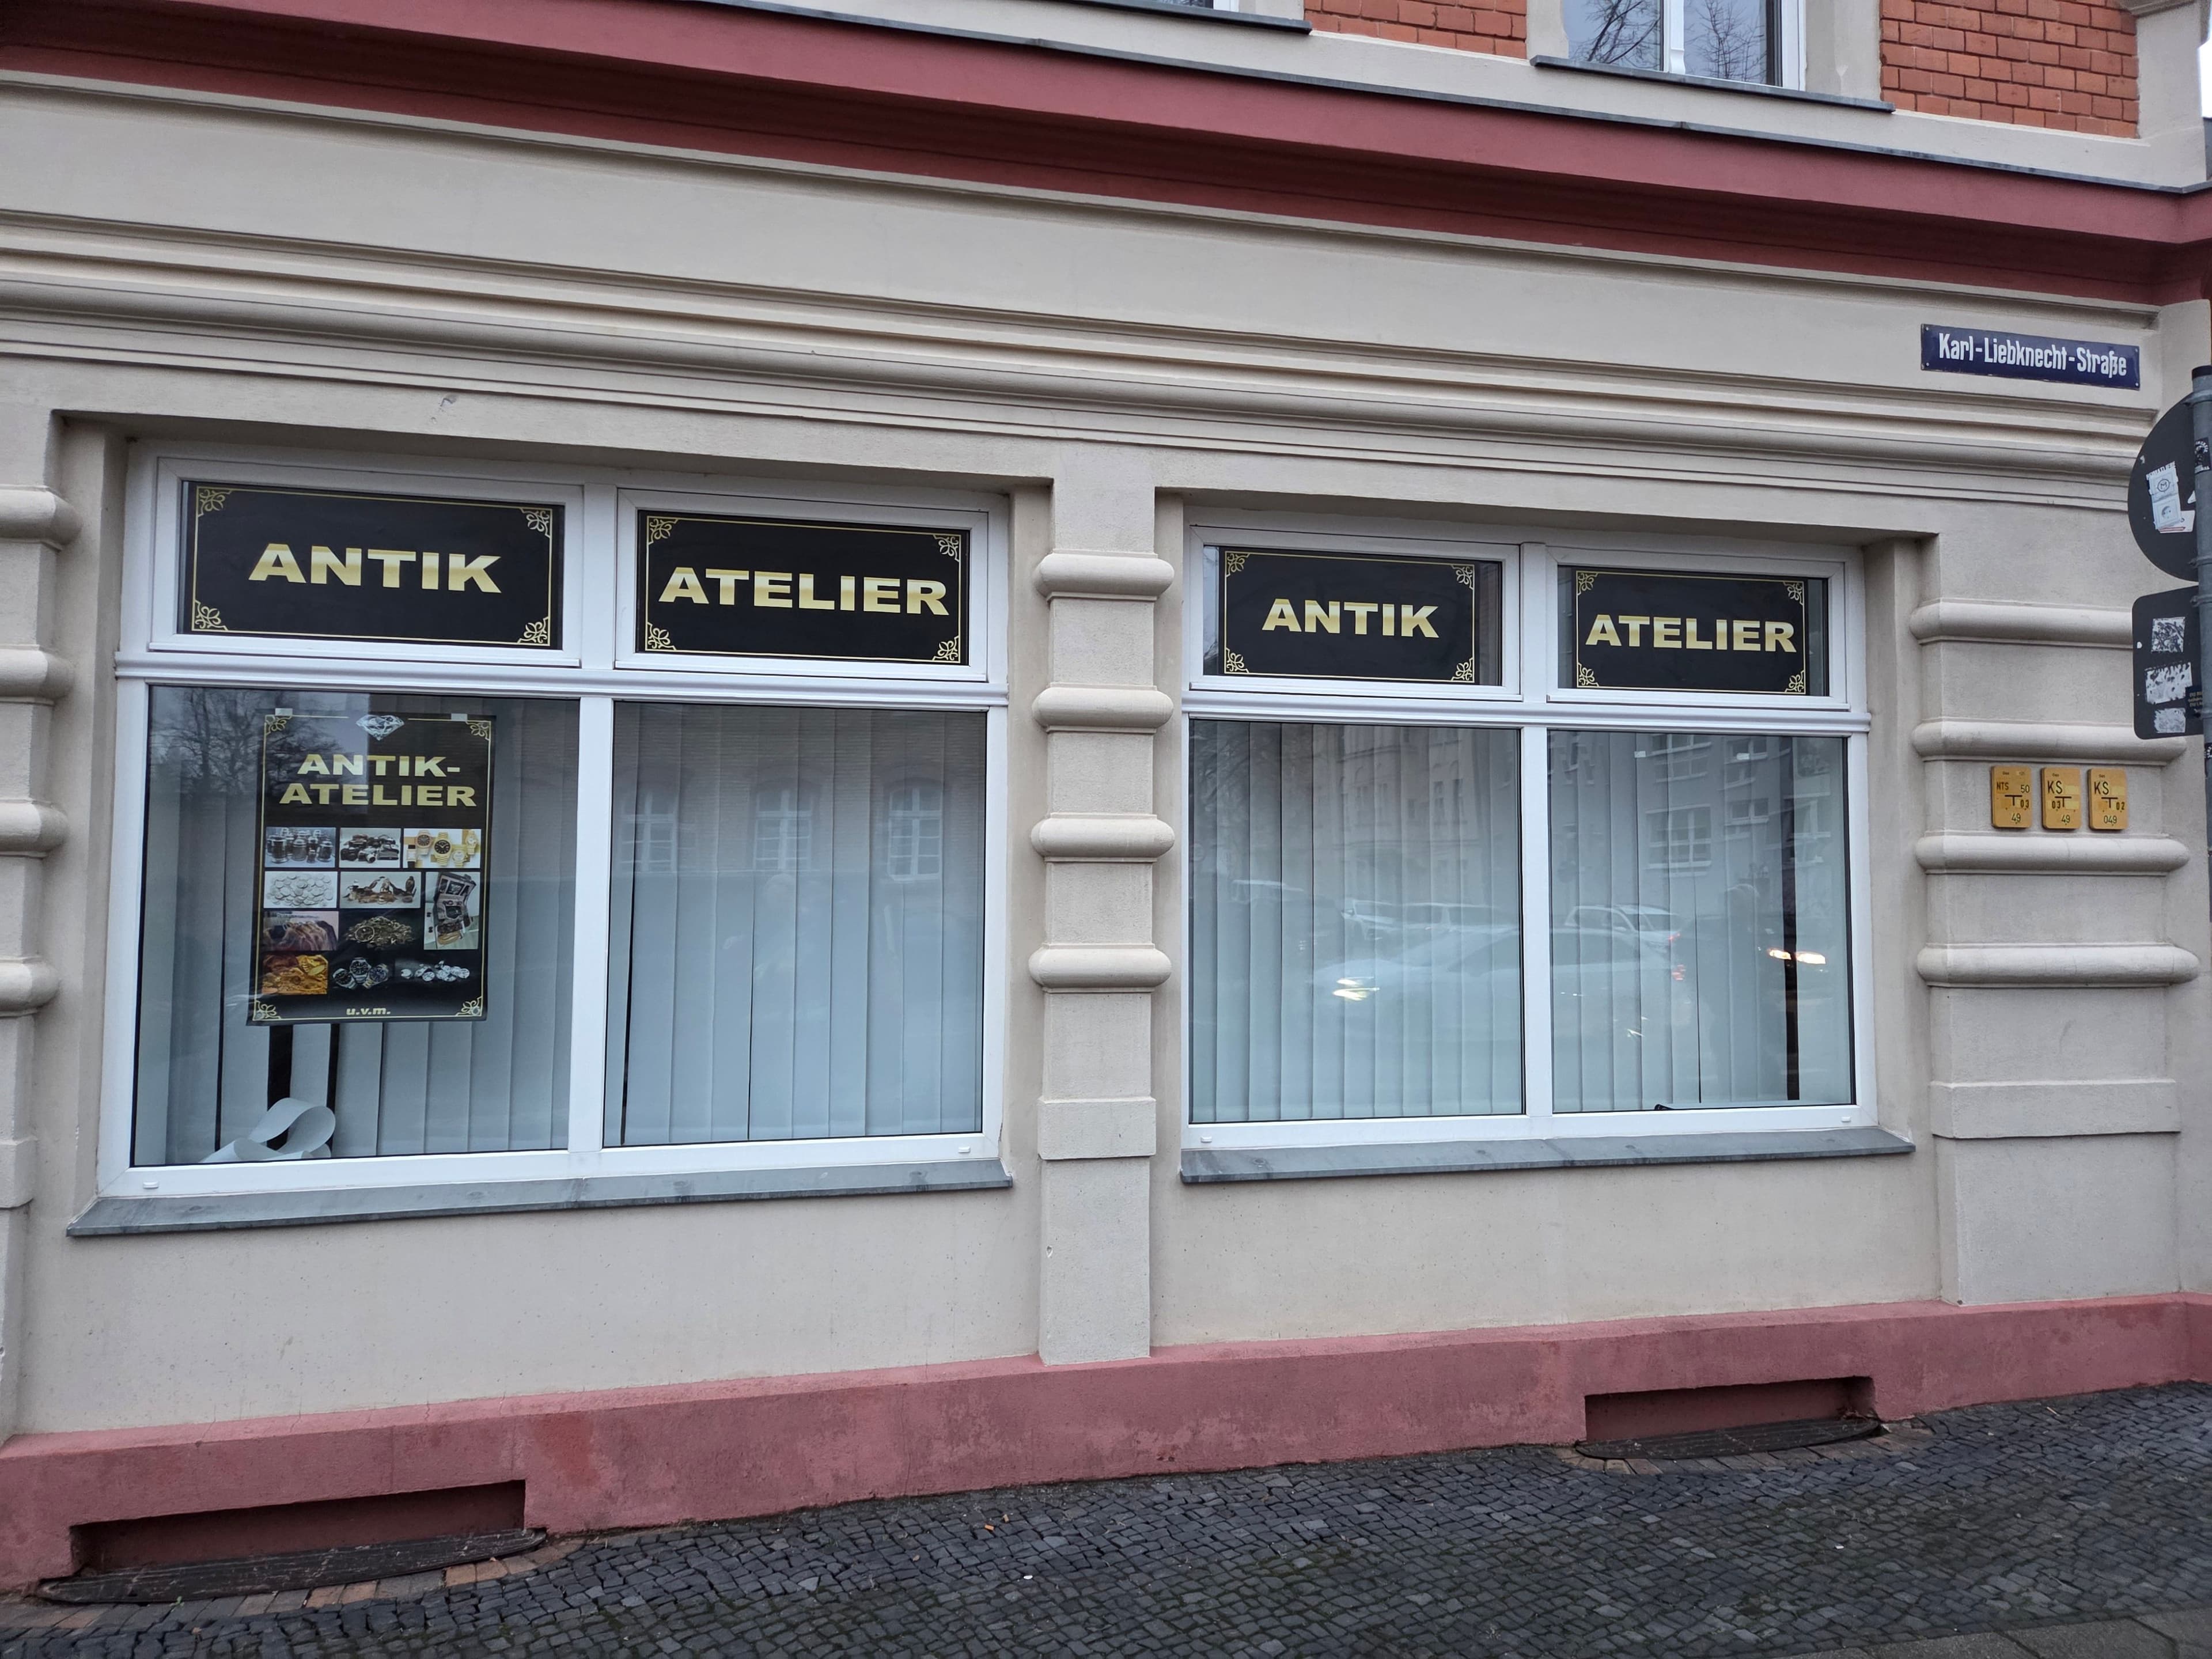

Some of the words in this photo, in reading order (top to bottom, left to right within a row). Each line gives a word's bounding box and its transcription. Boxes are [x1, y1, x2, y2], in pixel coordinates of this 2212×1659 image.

[1938, 332, 2127, 379] Karl-Liebknecht-Straße
[248, 543, 502, 593] ANTIK
[658, 567, 949, 616] ATELIER
[1262, 598, 1439, 638] ANTIK
[1585, 614, 1797, 653] ATELIER
[297, 753, 460, 777] ANTIK-
[279, 783, 476, 806] ATELIER
[2020, 785, 2030, 793] 50
[2047, 781, 2063, 794] KS
[2094, 781, 2109, 795] KS
[346, 1007, 391, 1016] u.v.m.
